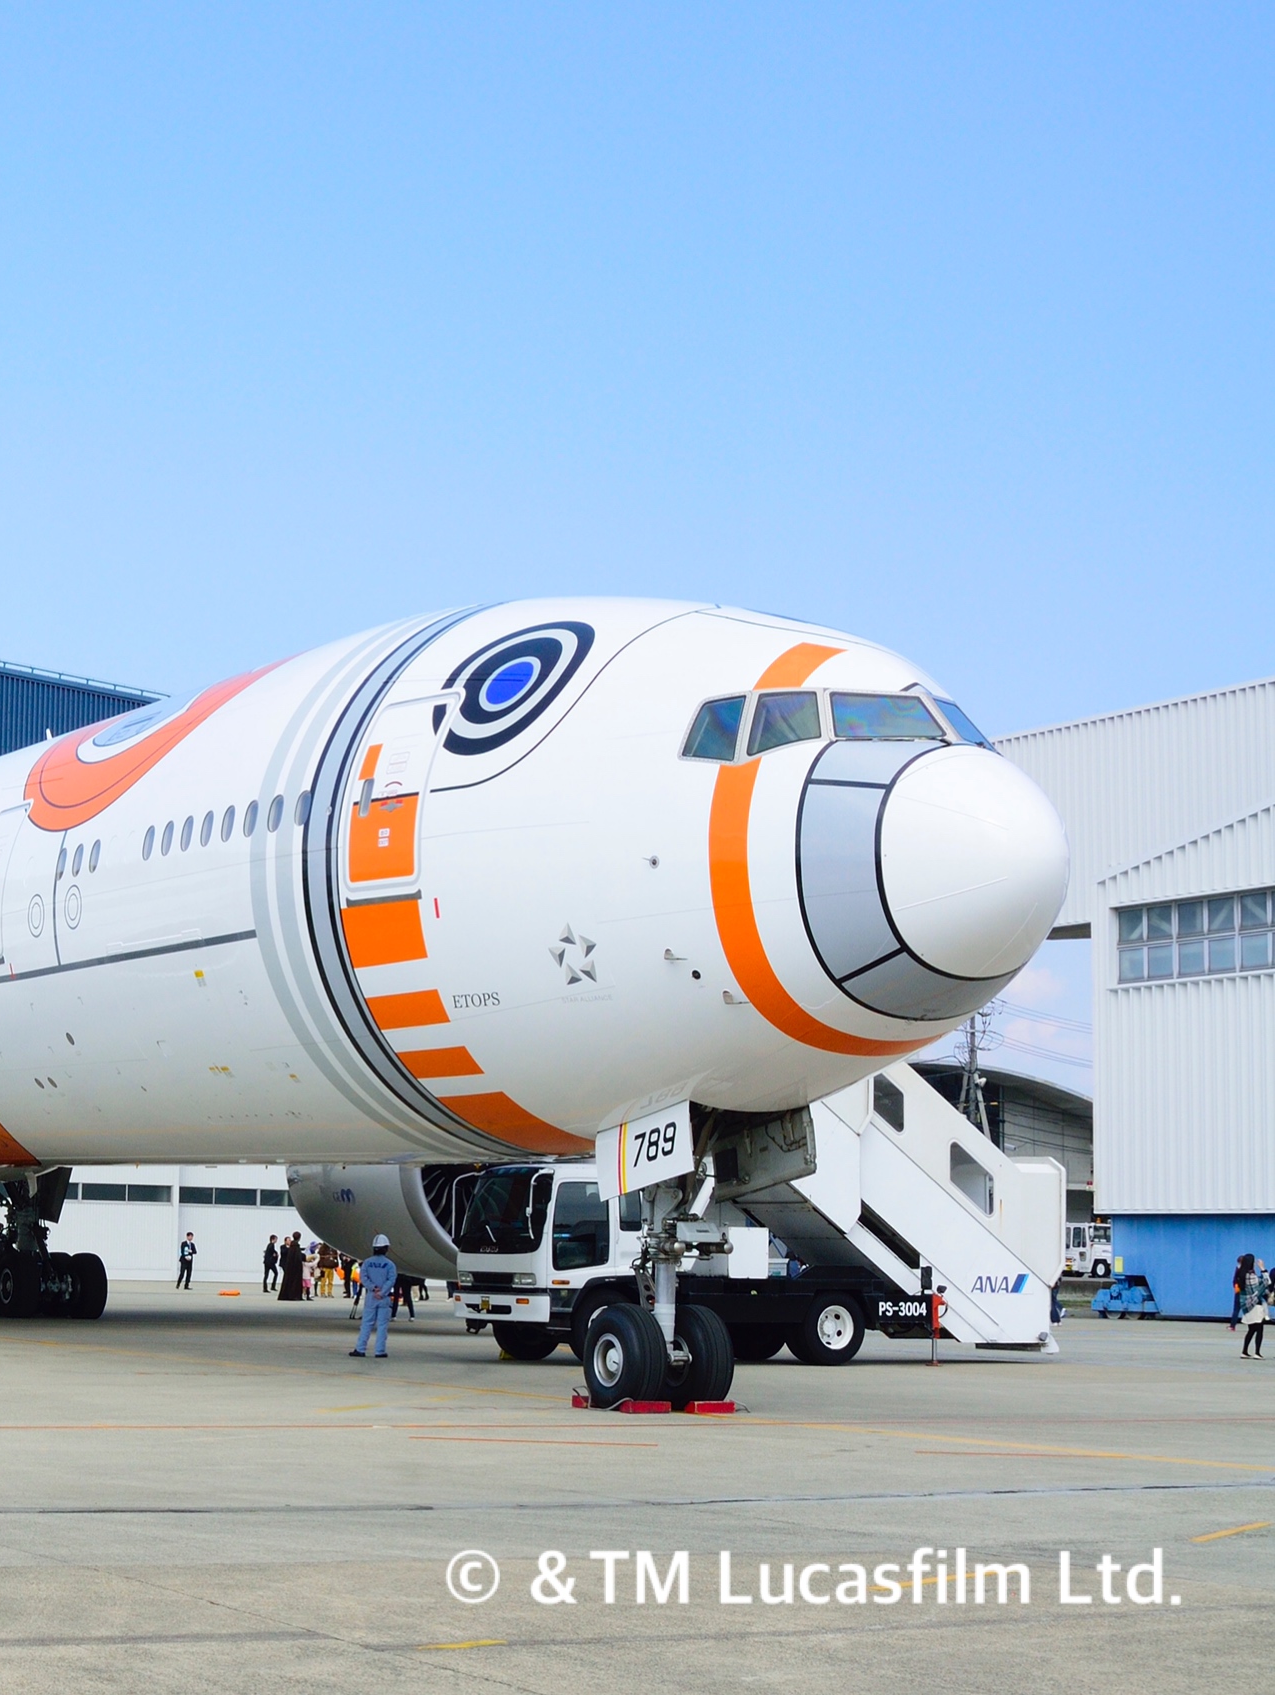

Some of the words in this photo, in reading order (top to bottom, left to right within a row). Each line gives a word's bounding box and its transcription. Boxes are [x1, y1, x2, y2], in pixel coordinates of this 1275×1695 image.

[452, 991, 501, 1009] ETOPS
[633, 1121, 677, 1168] 789
[970, 1275, 1011, 1293] ANA
[878, 1301, 927, 1317] PS-3004
